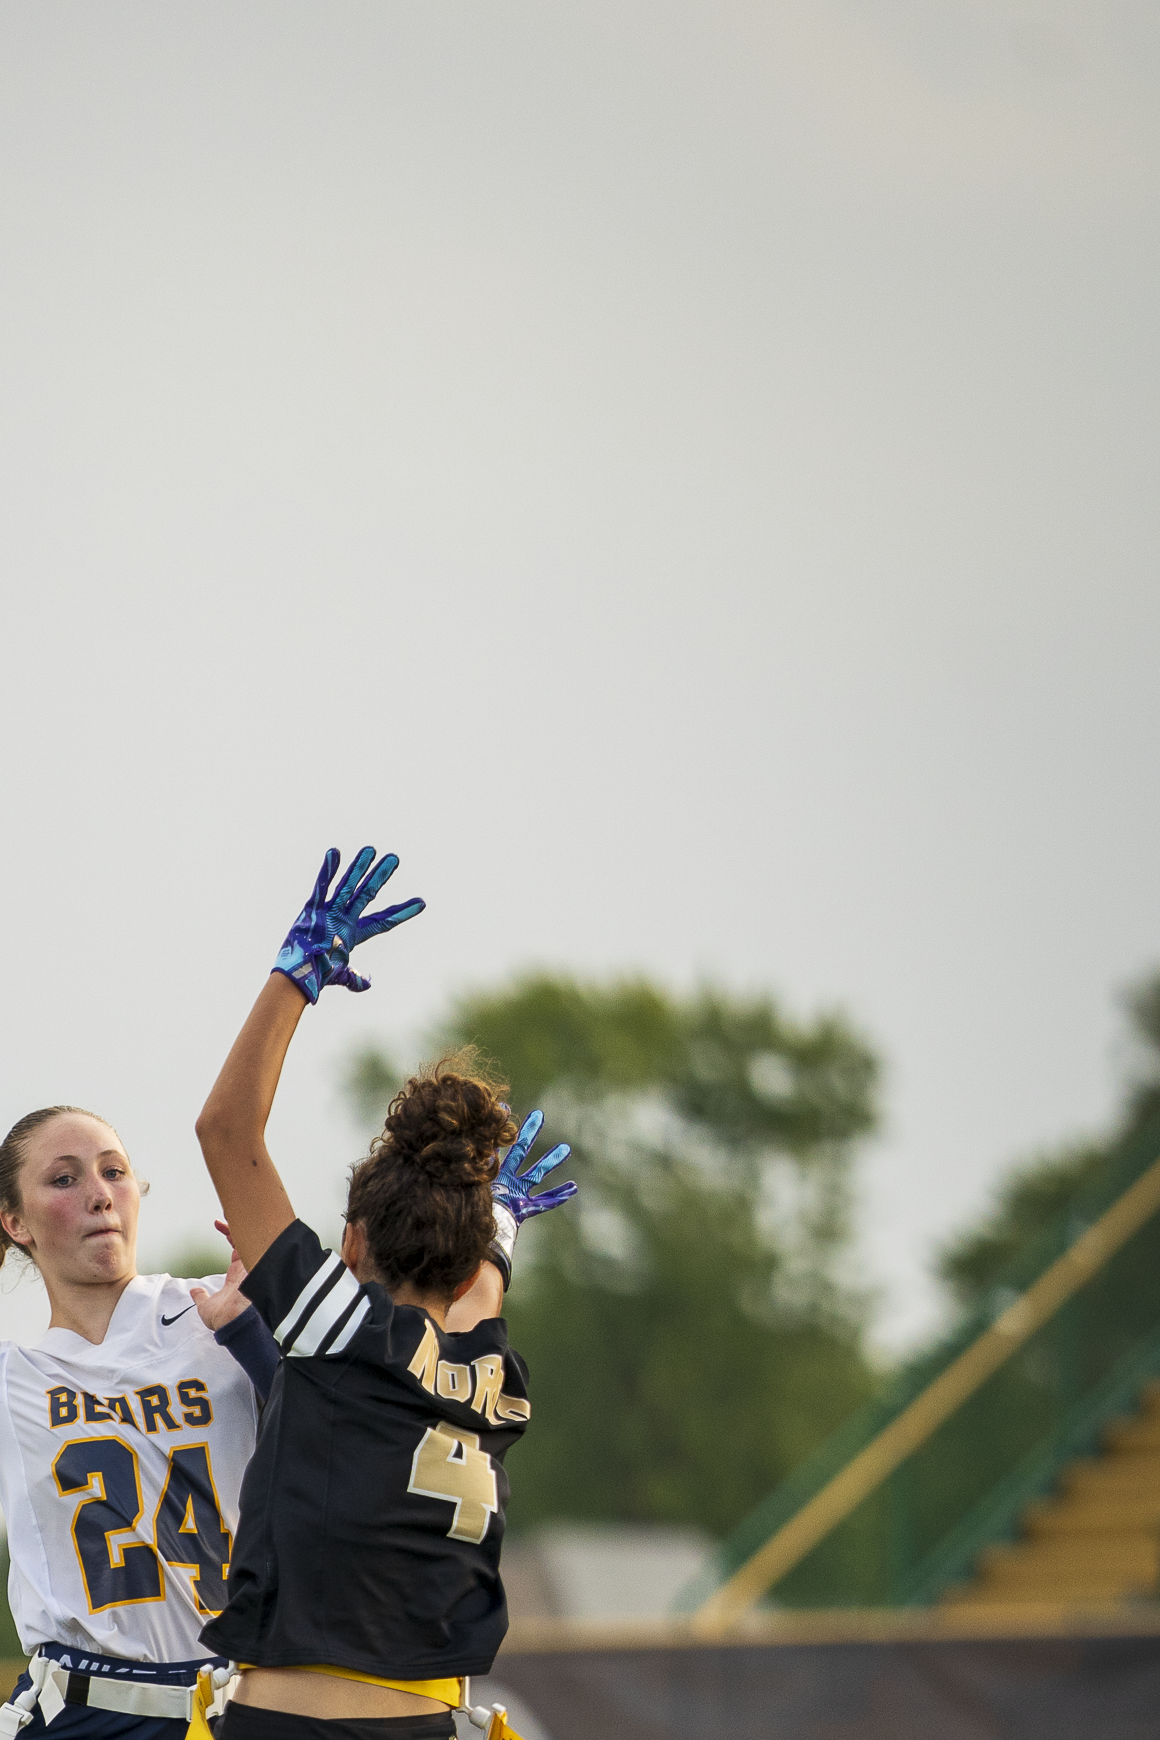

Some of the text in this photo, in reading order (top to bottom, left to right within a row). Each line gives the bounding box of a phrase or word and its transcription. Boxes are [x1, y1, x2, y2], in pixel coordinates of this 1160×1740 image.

[45, 1378, 214, 1434] BEARS
[51, 1435, 234, 1619] 24
[407, 1420, 498, 1544] 4
